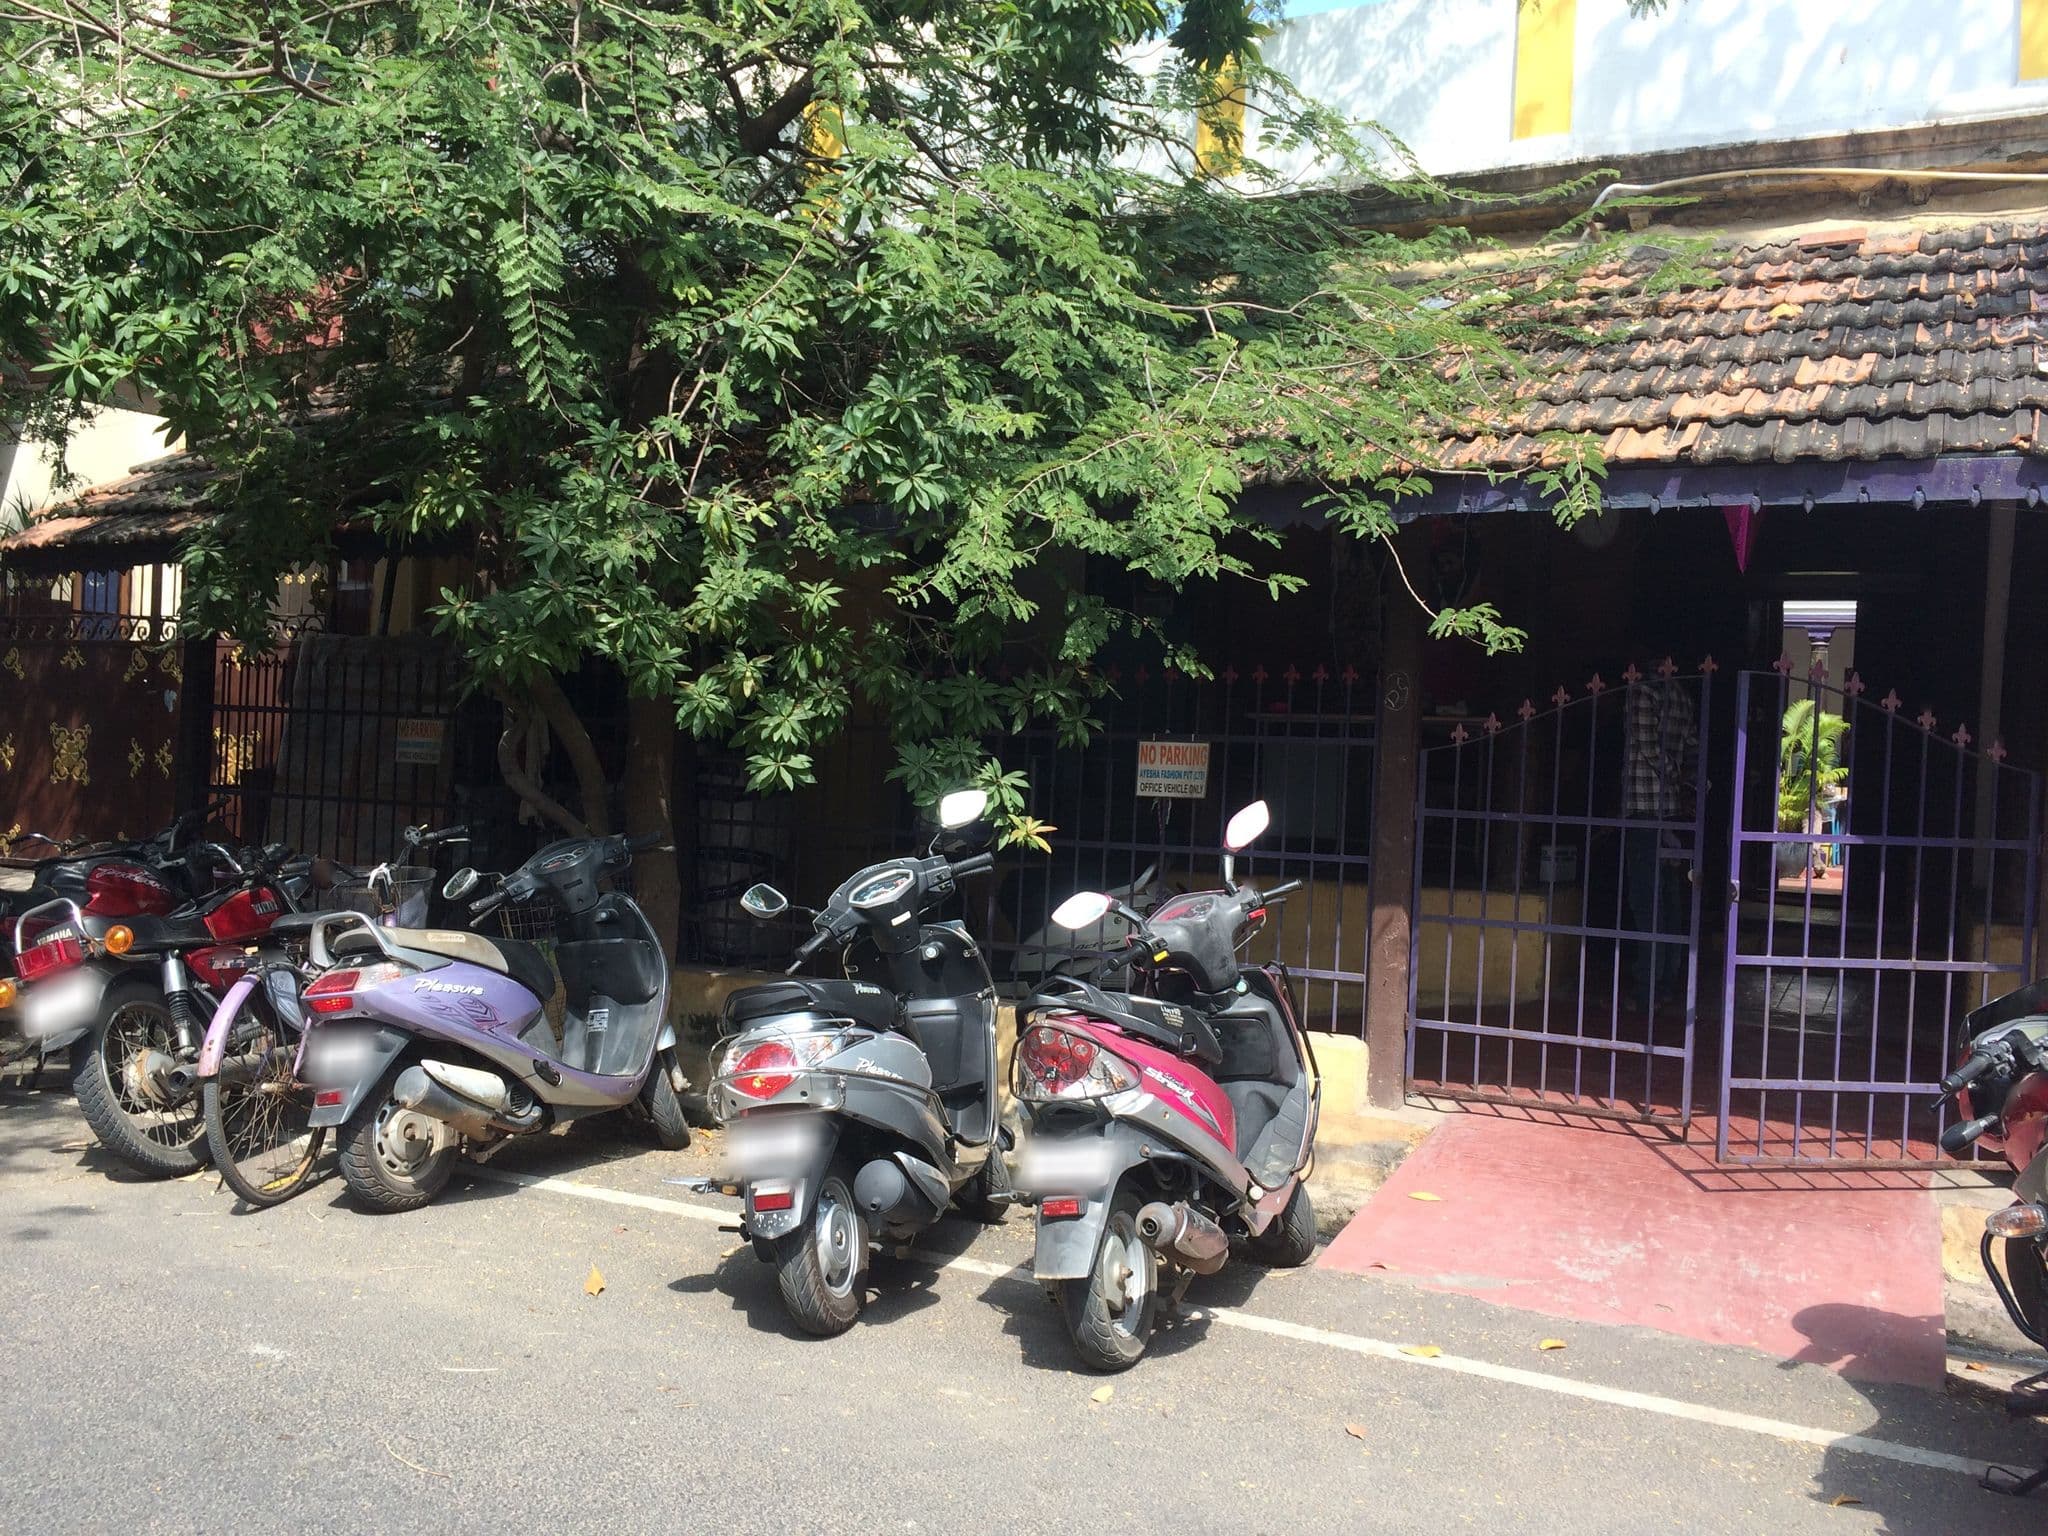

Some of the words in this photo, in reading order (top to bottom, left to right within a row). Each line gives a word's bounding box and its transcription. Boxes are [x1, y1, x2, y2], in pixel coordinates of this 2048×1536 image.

[1140, 744, 1157, 765] NO
[1160, 745, 1208, 767] PARKING
[1140, 783, 1162, 793] OFFICE
[1164, 784, 1188, 794] VEHICLE
[1189, 785, 1204, 794] ONLY
[37, 928, 73, 946] YAMAHA
[414, 979, 484, 996] Pleasure
